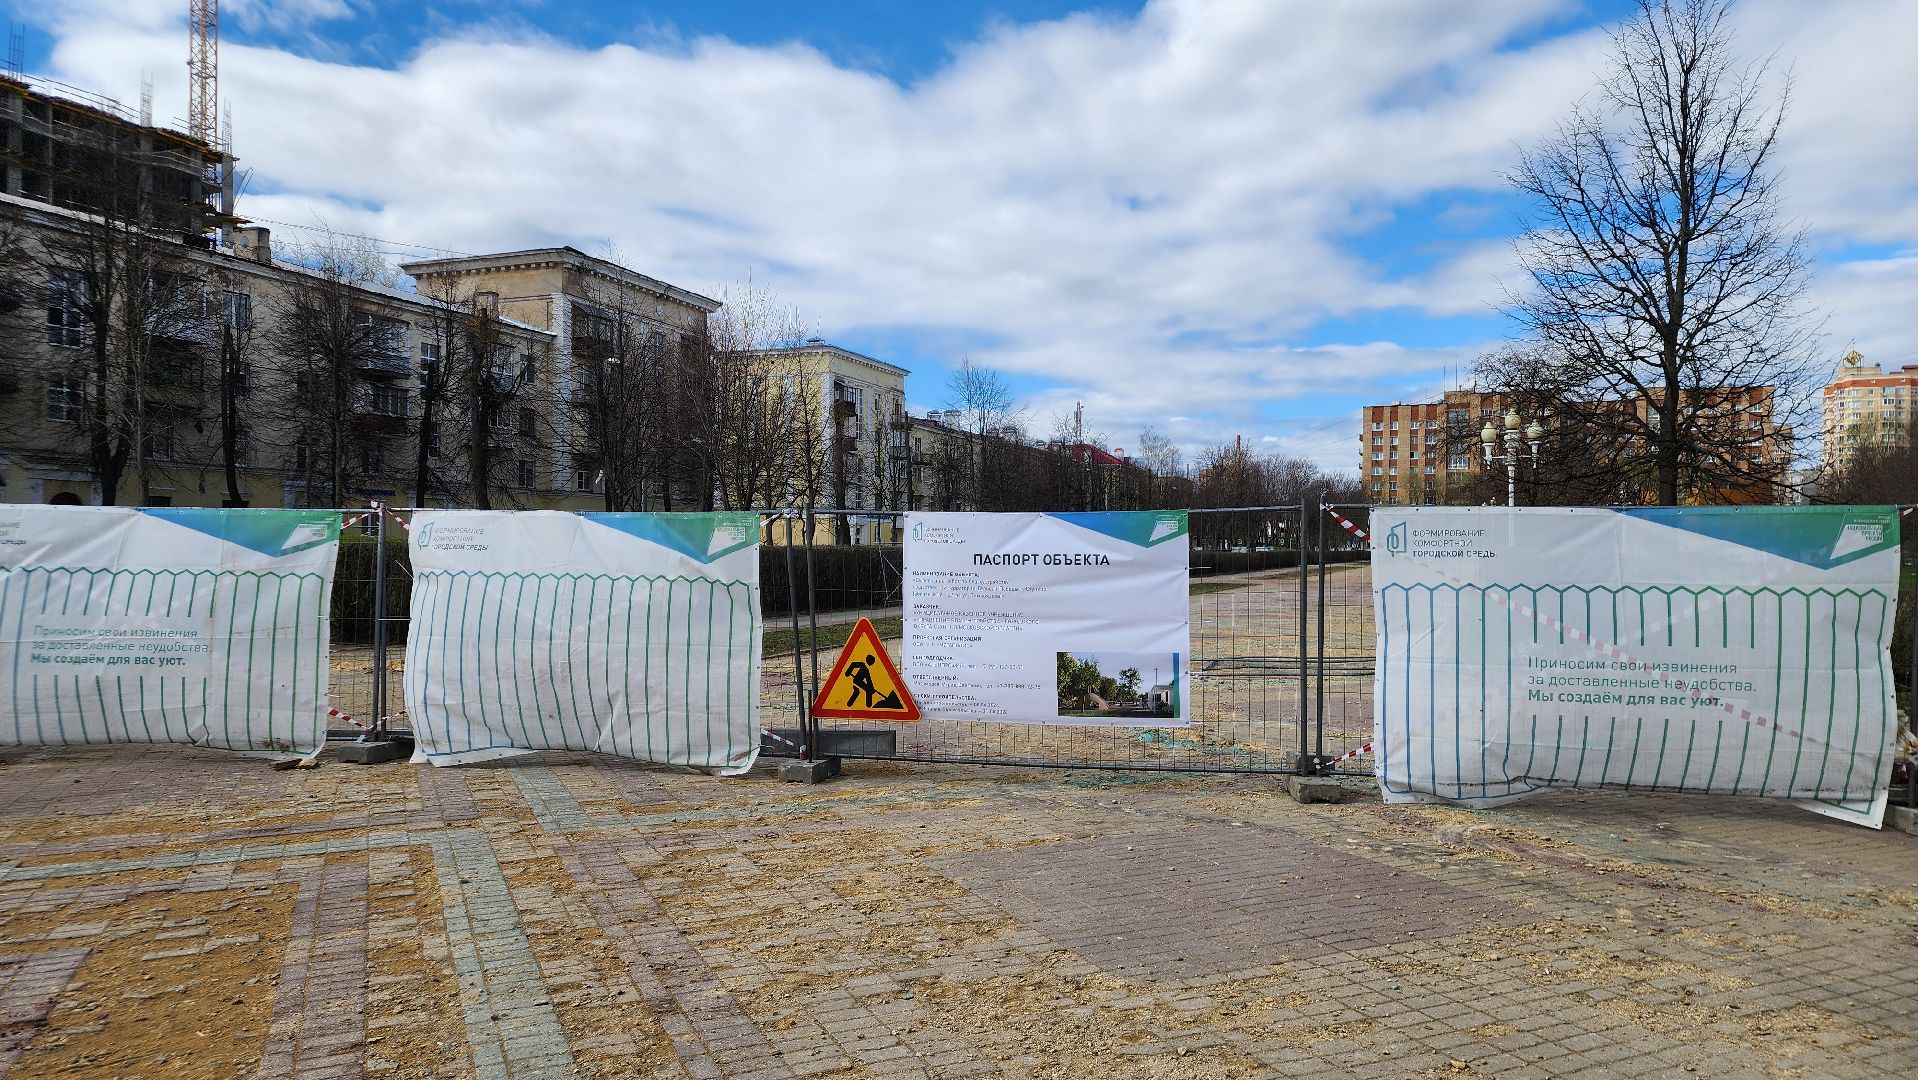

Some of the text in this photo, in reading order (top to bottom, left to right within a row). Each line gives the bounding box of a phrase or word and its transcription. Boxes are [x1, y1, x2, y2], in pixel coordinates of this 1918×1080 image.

[1412, 529, 1486, 539] ФОРМИРОВАНИЕ
[973, 553, 1111, 567] ПАСПОРТ ОБЪЕКТА
[1412, 548, 1464, 560] ГОРОДСКОЙ
[33, 624, 199, 640] Приносим свои извинения
[31, 640, 212, 655] за доставленные неудобства.
[30, 652, 187, 668] Мы создаём для вас уют.
[1527, 656, 1738, 674] Приносим свои извинения
[1527, 675, 1758, 694] за доставленные неудобства.
[1527, 689, 1725, 710] Мы создаём для вас уют.
